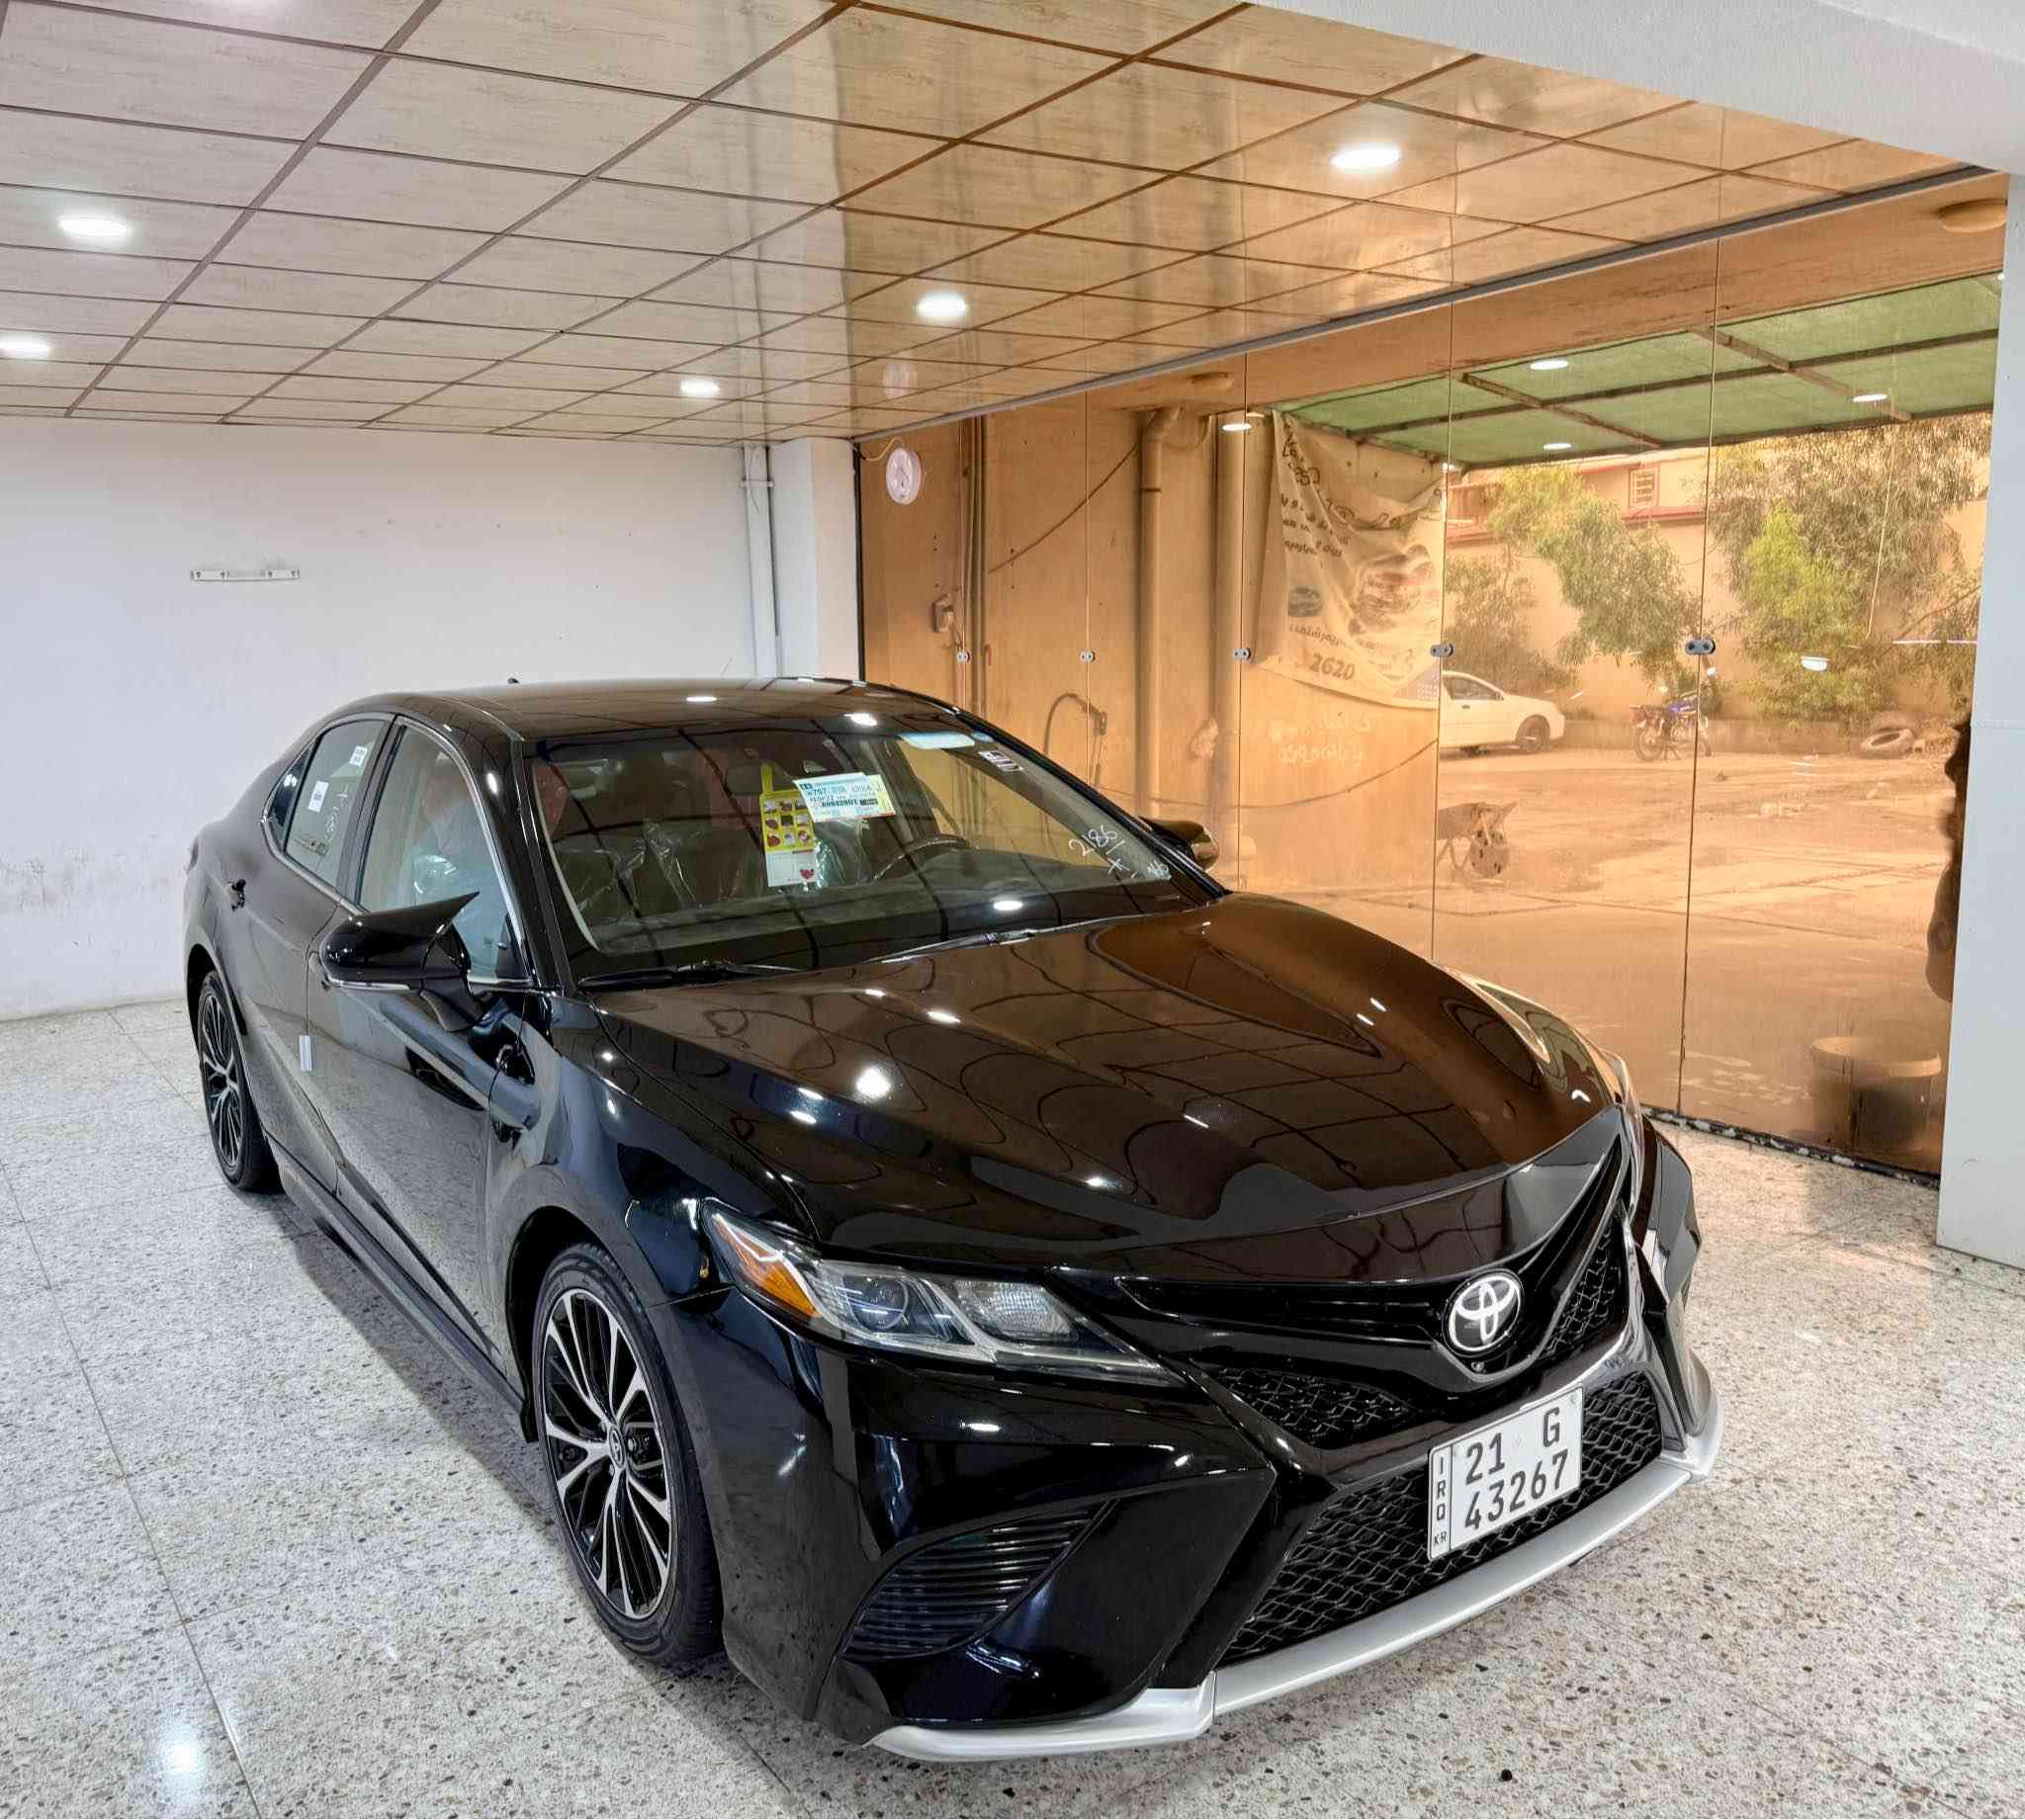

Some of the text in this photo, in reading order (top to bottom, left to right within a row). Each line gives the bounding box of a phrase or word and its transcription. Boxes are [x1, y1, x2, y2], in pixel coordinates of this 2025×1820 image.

[1309, 652, 1356, 680] 2620
[1464, 1406, 1560, 1486] 21 G
[1464, 1448, 1569, 1530] 43267
